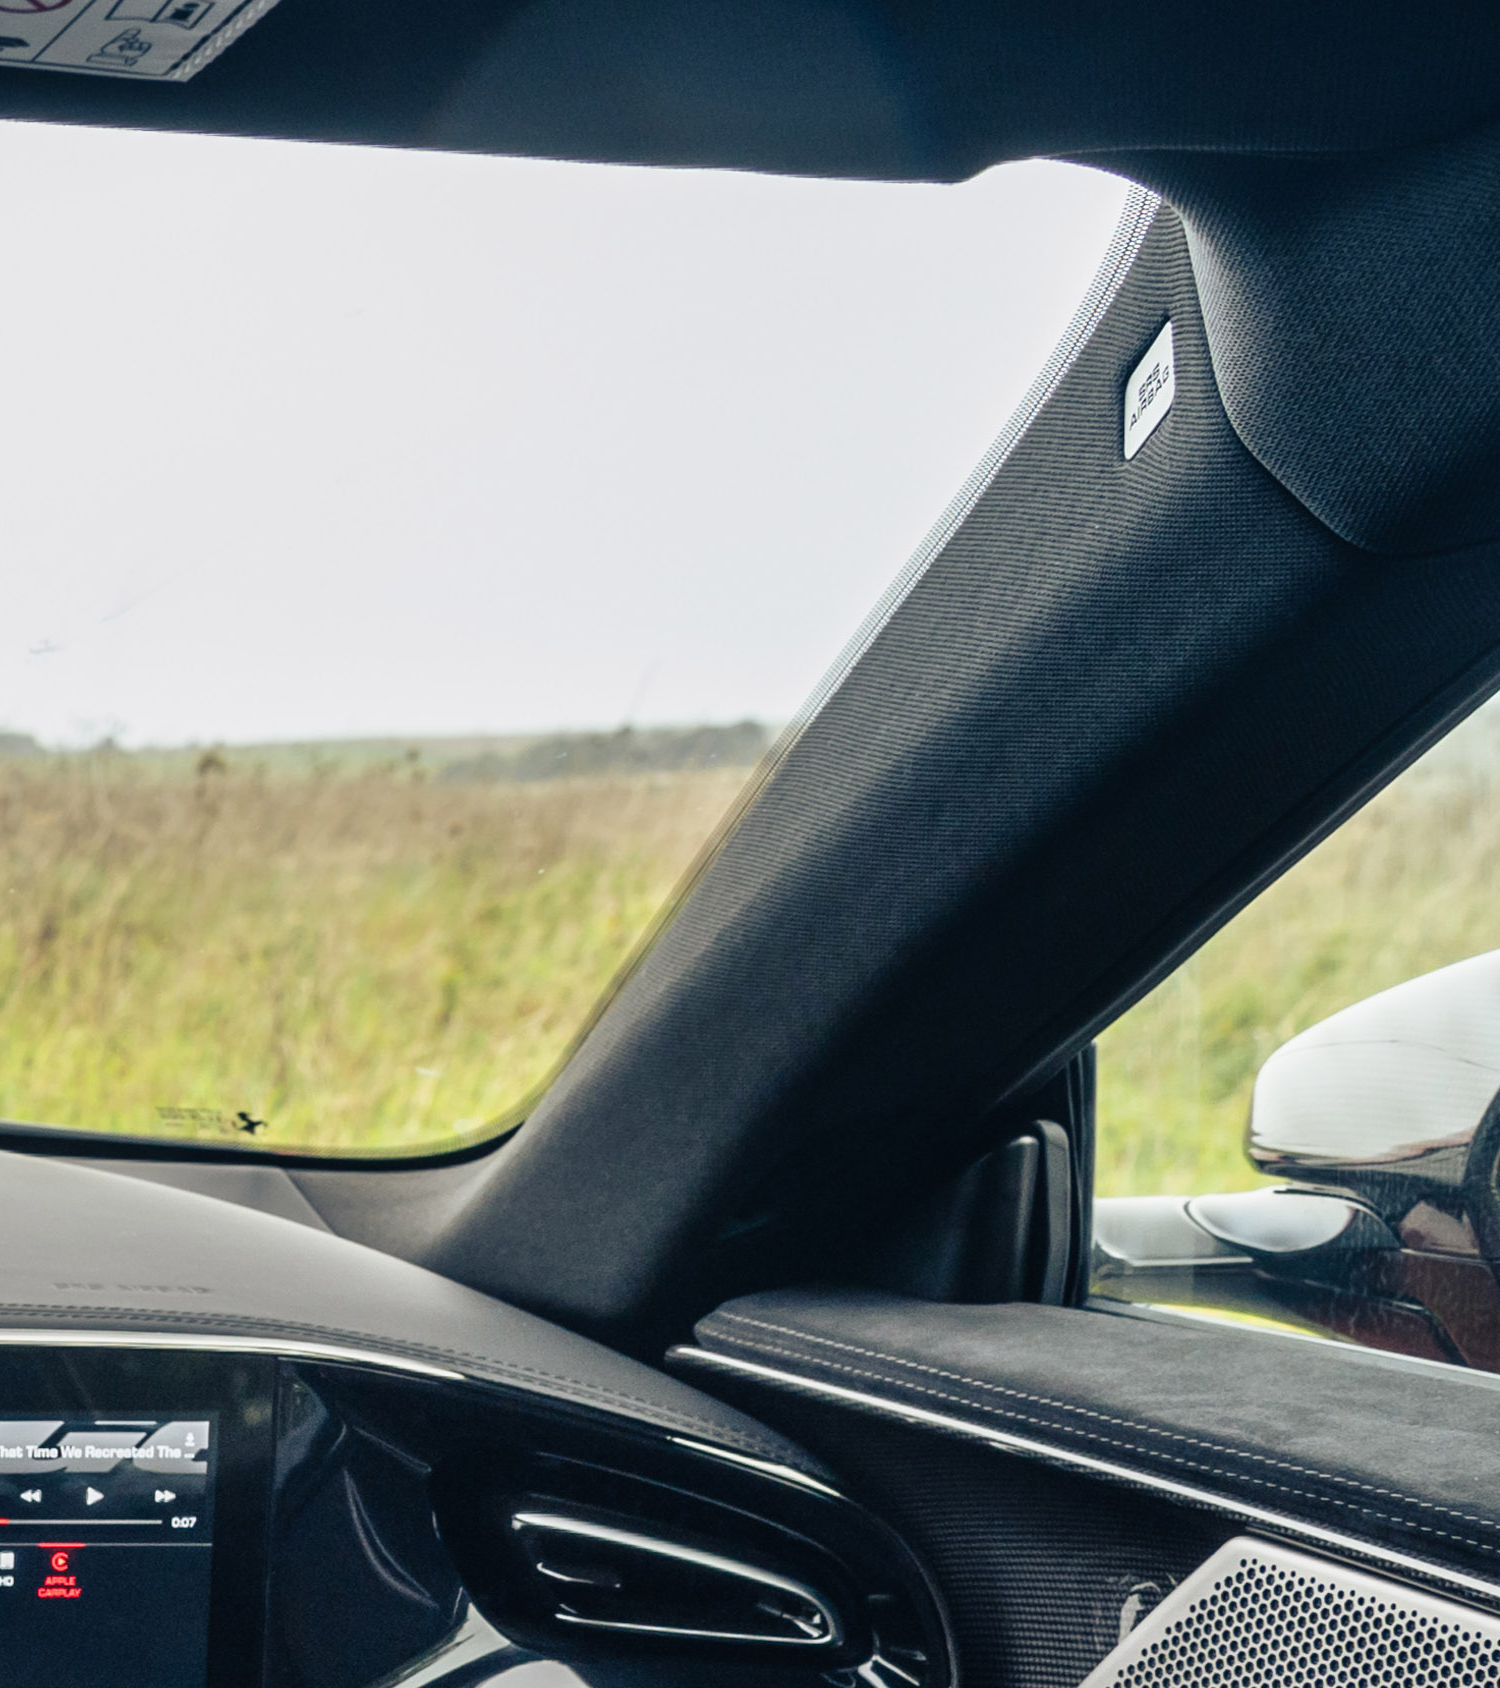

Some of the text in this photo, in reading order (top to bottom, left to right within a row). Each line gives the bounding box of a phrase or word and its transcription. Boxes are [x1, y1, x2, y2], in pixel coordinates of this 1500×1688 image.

[1129, 365, 1170, 431] AIRBAG
[26, 1445, 58, 1459] Time
[61, 1445, 83, 1459] We
[85, 1445, 154, 1459] Recreated
[157, 1445, 182, 1459] The
[171, 1516, 197, 1529] 0:07
[44, 1576, 76, 1587] APPLE
[37, 1587, 81, 1598] CARPLAY
